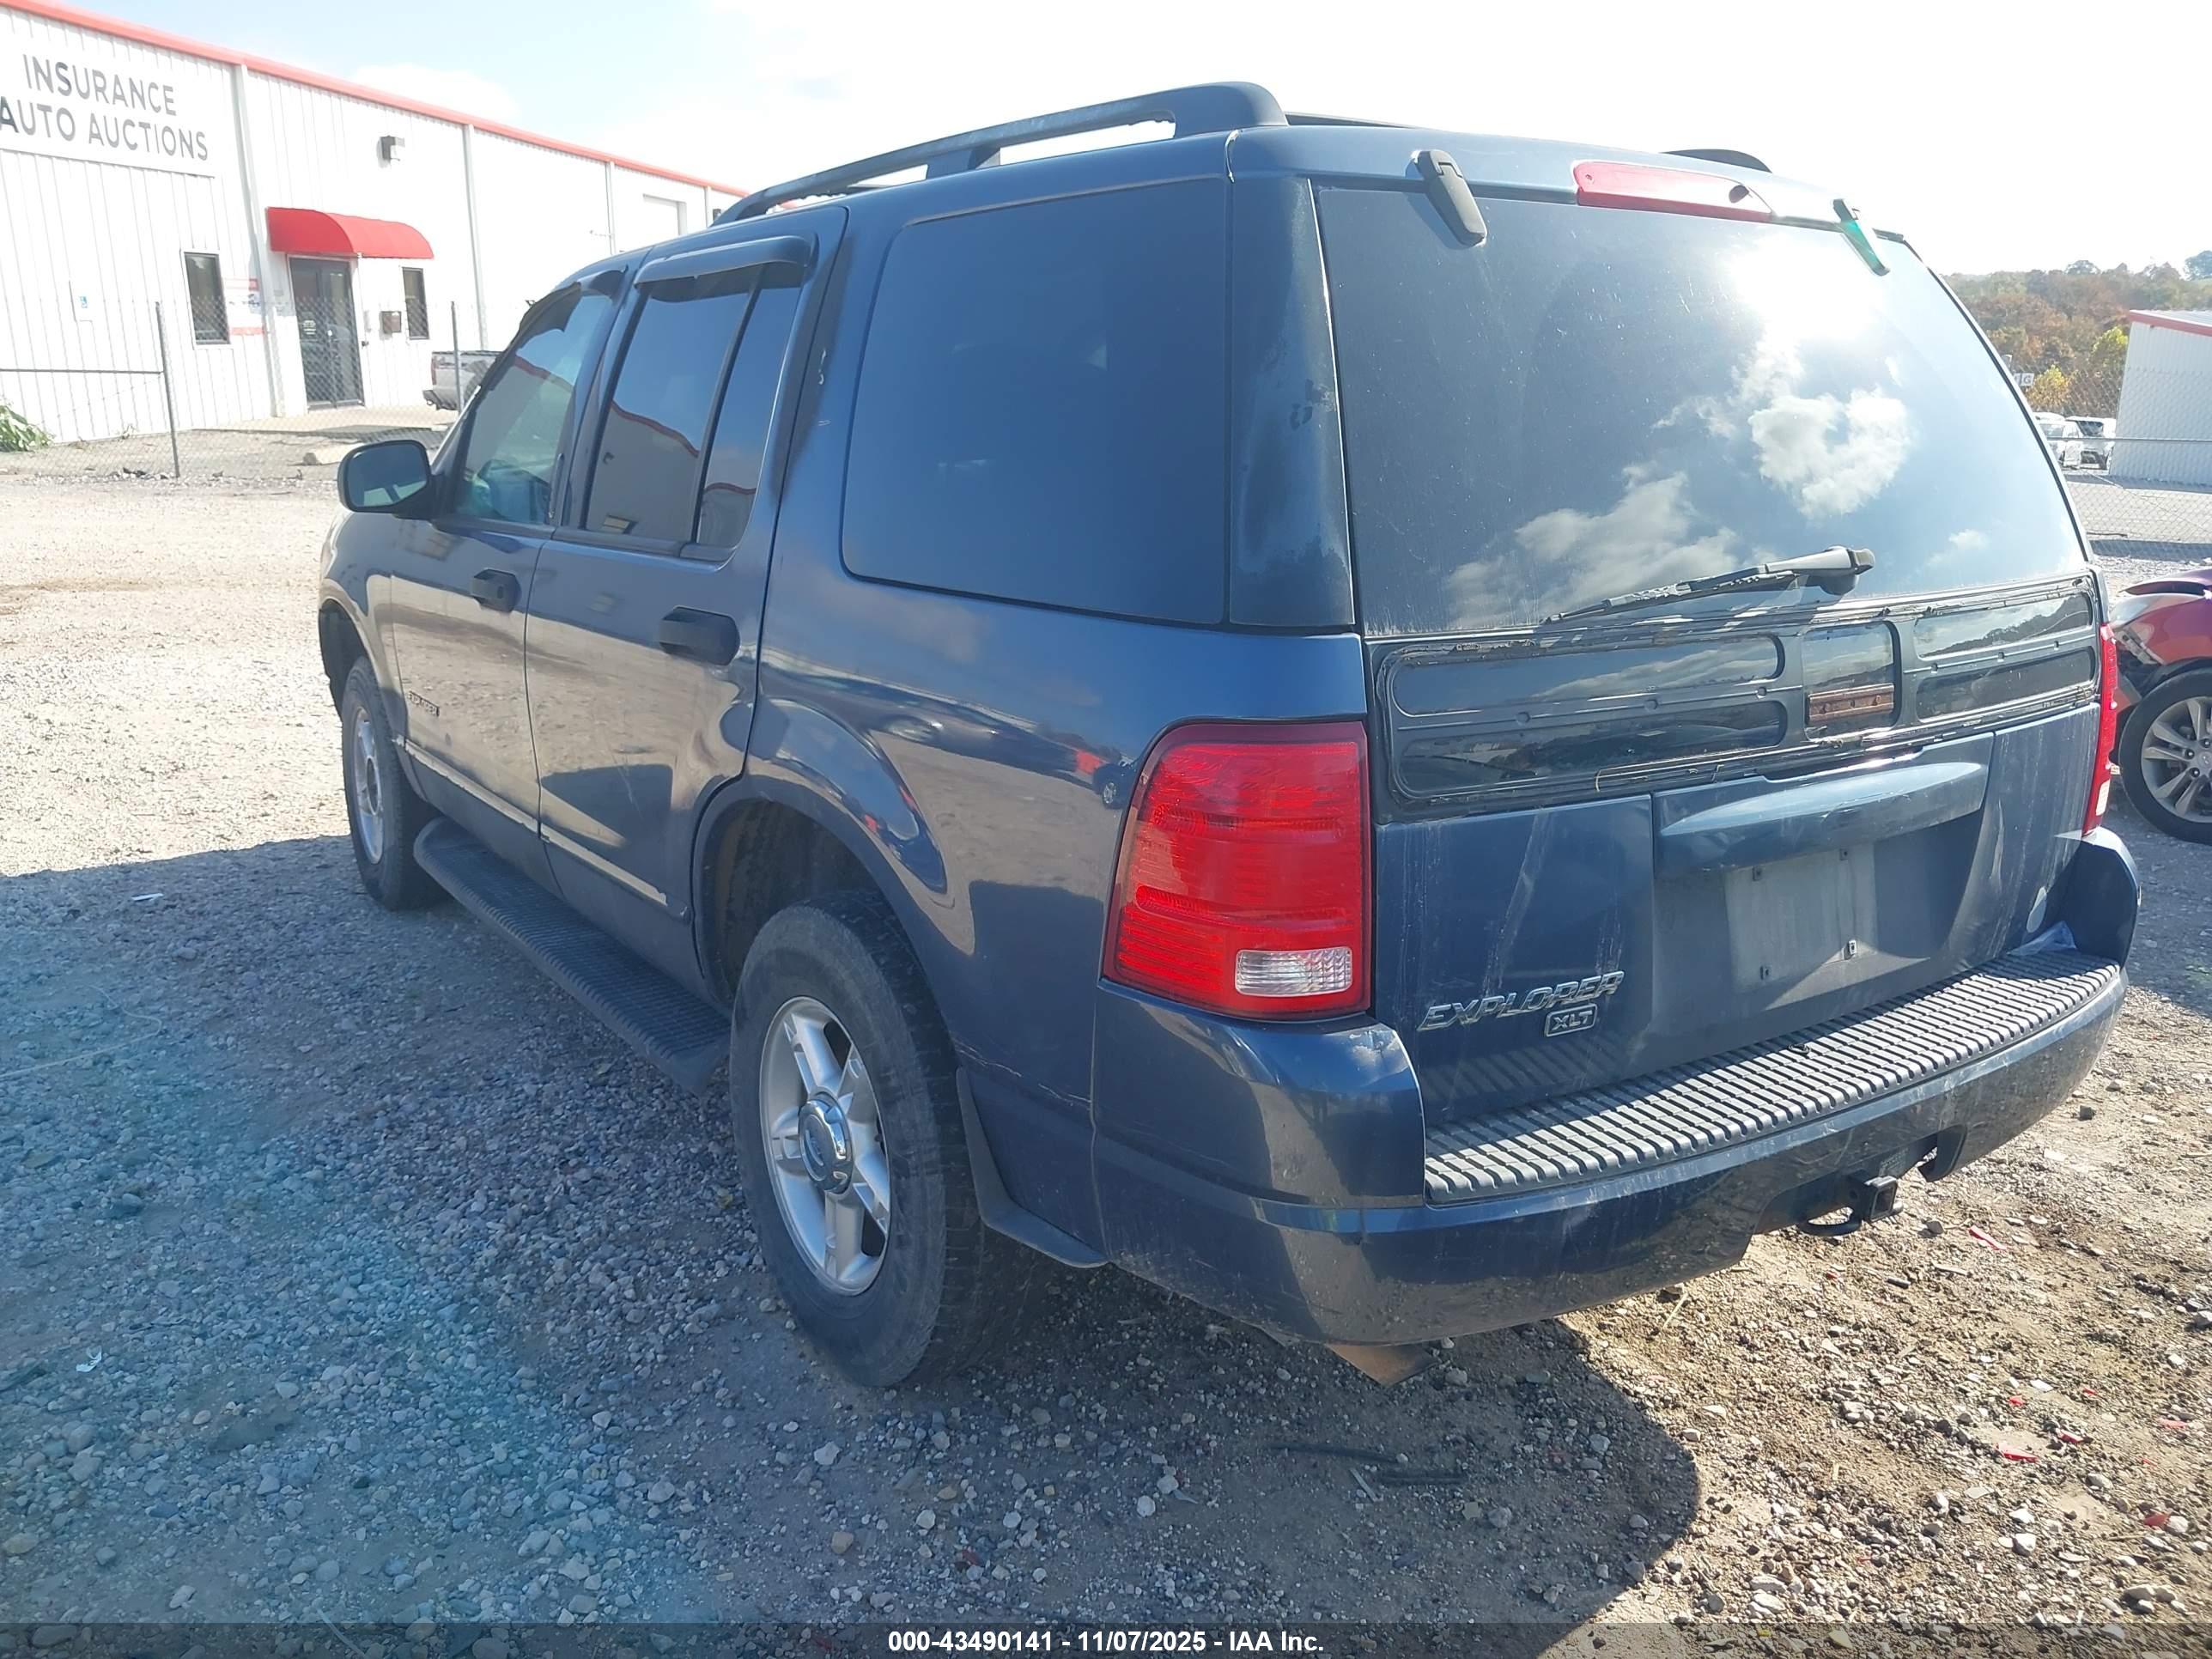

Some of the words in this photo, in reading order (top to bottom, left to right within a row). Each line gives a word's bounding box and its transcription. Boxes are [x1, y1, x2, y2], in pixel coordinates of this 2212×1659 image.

[23, 54, 177, 116] INSURANCE
[0, 96, 76, 142] AUTO
[88, 112, 208, 161] AUCTIONS
[1417, 970, 1625, 1030] EXPLORER
[1552, 1010, 1593, 1030] XLT
